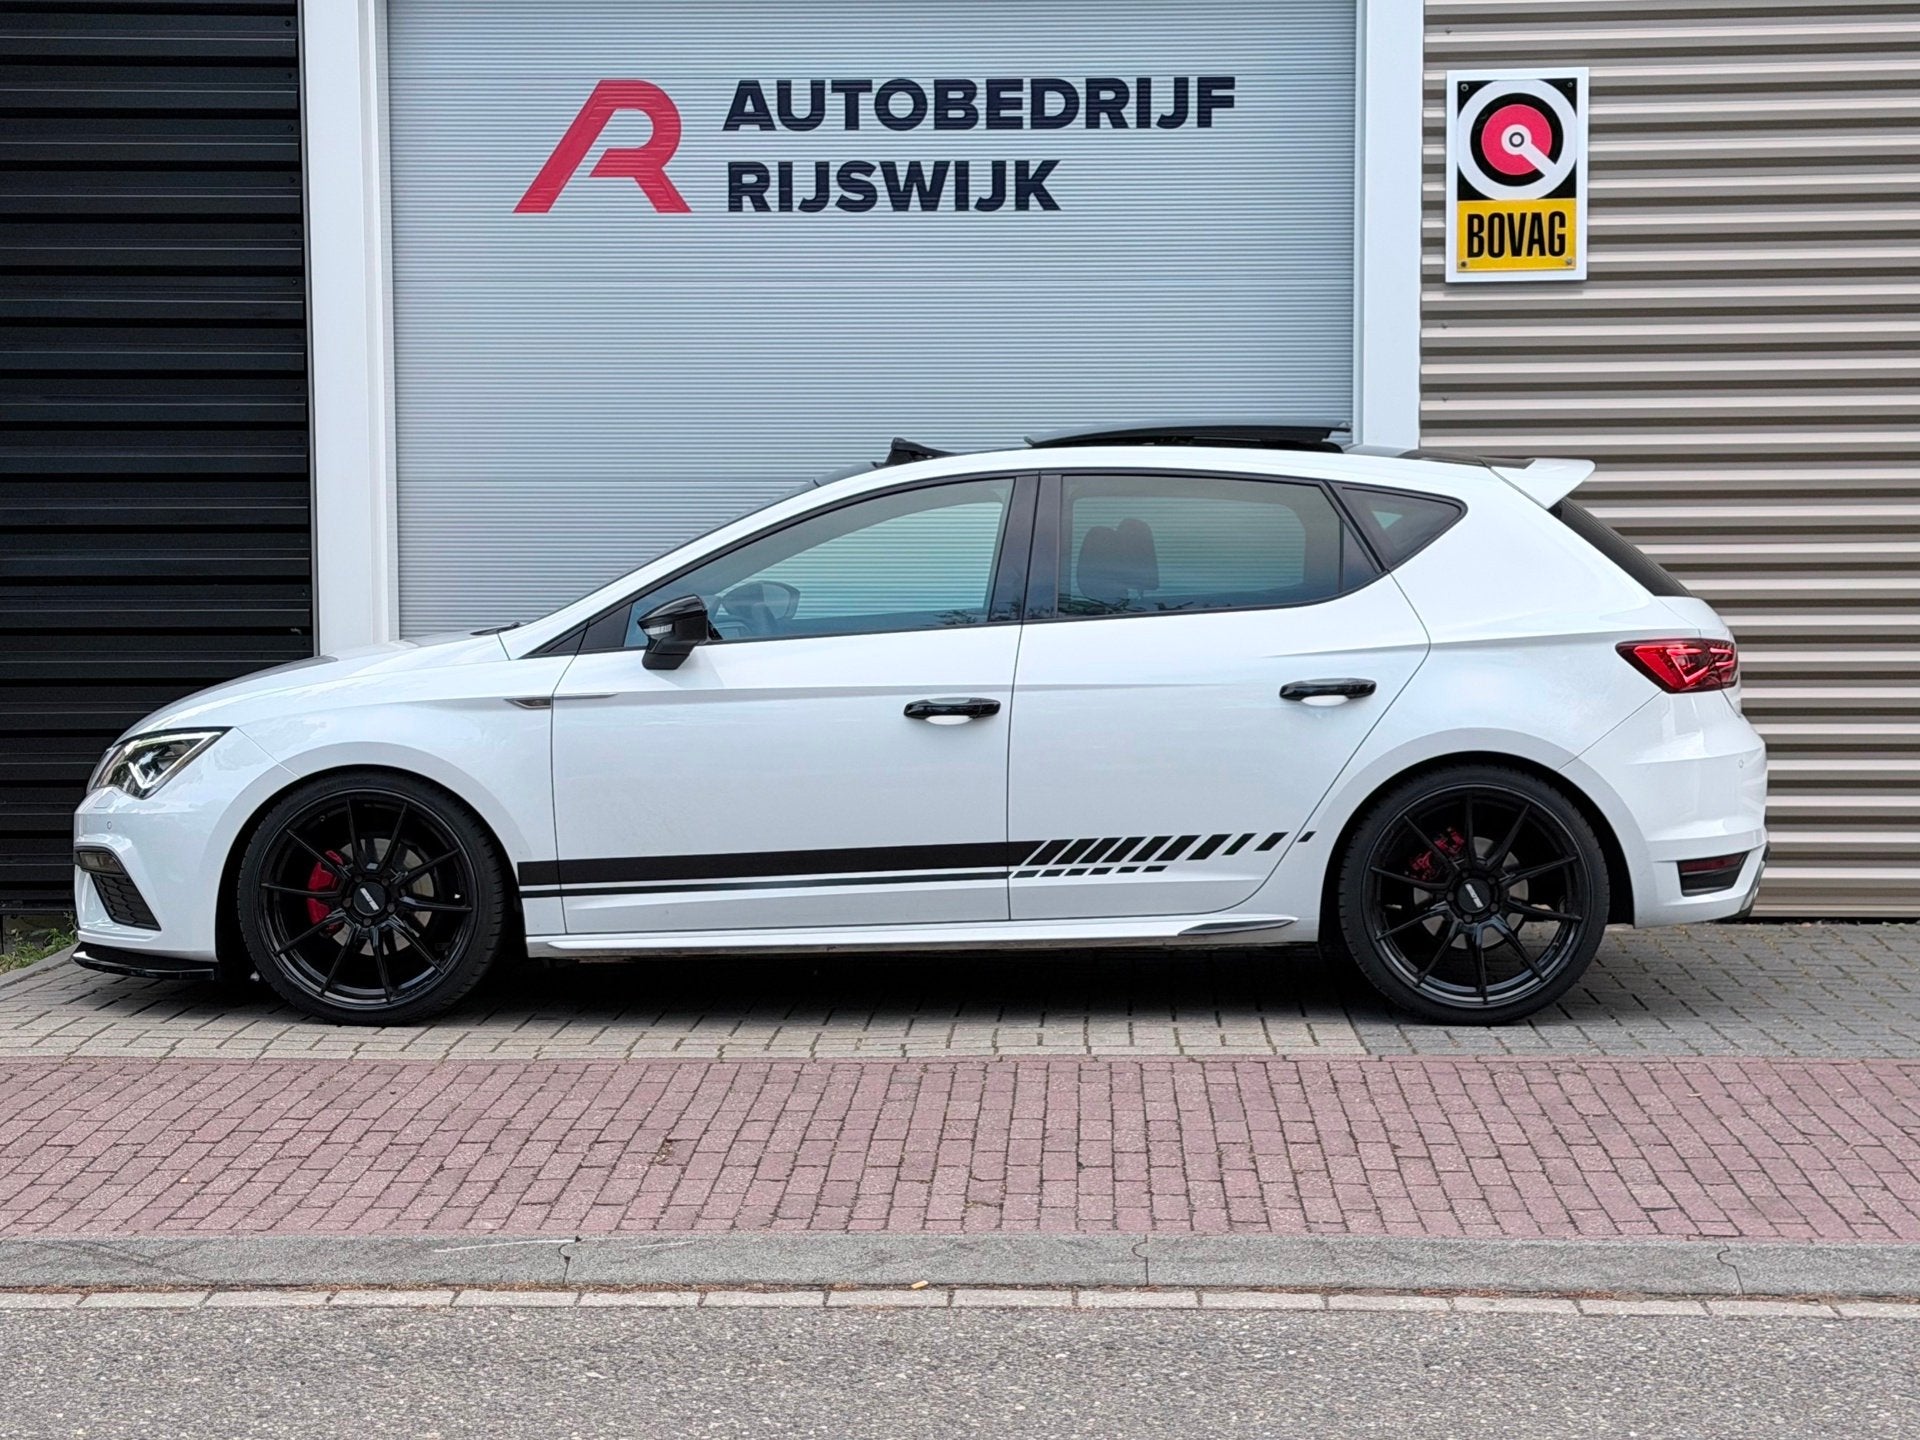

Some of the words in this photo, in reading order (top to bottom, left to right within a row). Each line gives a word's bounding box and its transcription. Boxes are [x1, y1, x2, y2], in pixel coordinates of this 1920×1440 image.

[722, 76, 1236, 131] AUTOBEDRIJF
[727, 160, 1061, 212] RIJSWIJK
[1467, 211, 1566, 258] BOVAG
